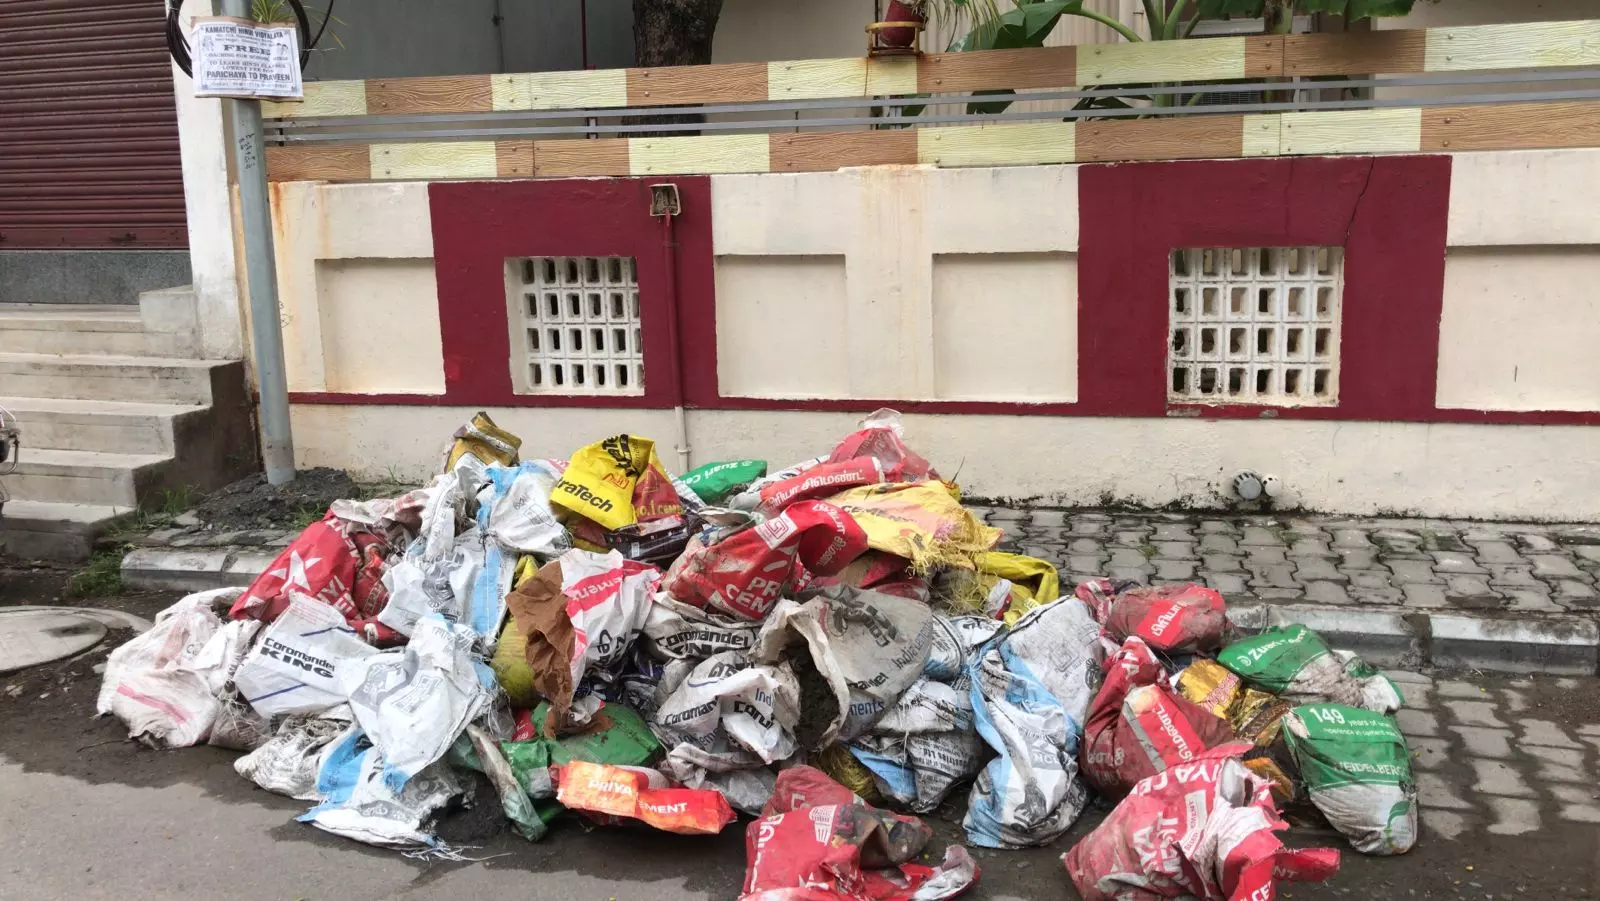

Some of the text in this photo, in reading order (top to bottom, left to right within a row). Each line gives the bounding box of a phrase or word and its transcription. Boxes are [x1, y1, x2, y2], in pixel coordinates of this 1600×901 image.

[223, 44, 271, 55] FREE
[206, 70, 291, 81] PARICHAYA TO PRAVEEN
[656, 629, 750, 649] Coromandel
[260, 646, 334, 679] KING
[264, 637, 335, 673] Coromandel
[1309, 707, 1346, 725] 149
[587, 778, 633, 797] PRIYA
